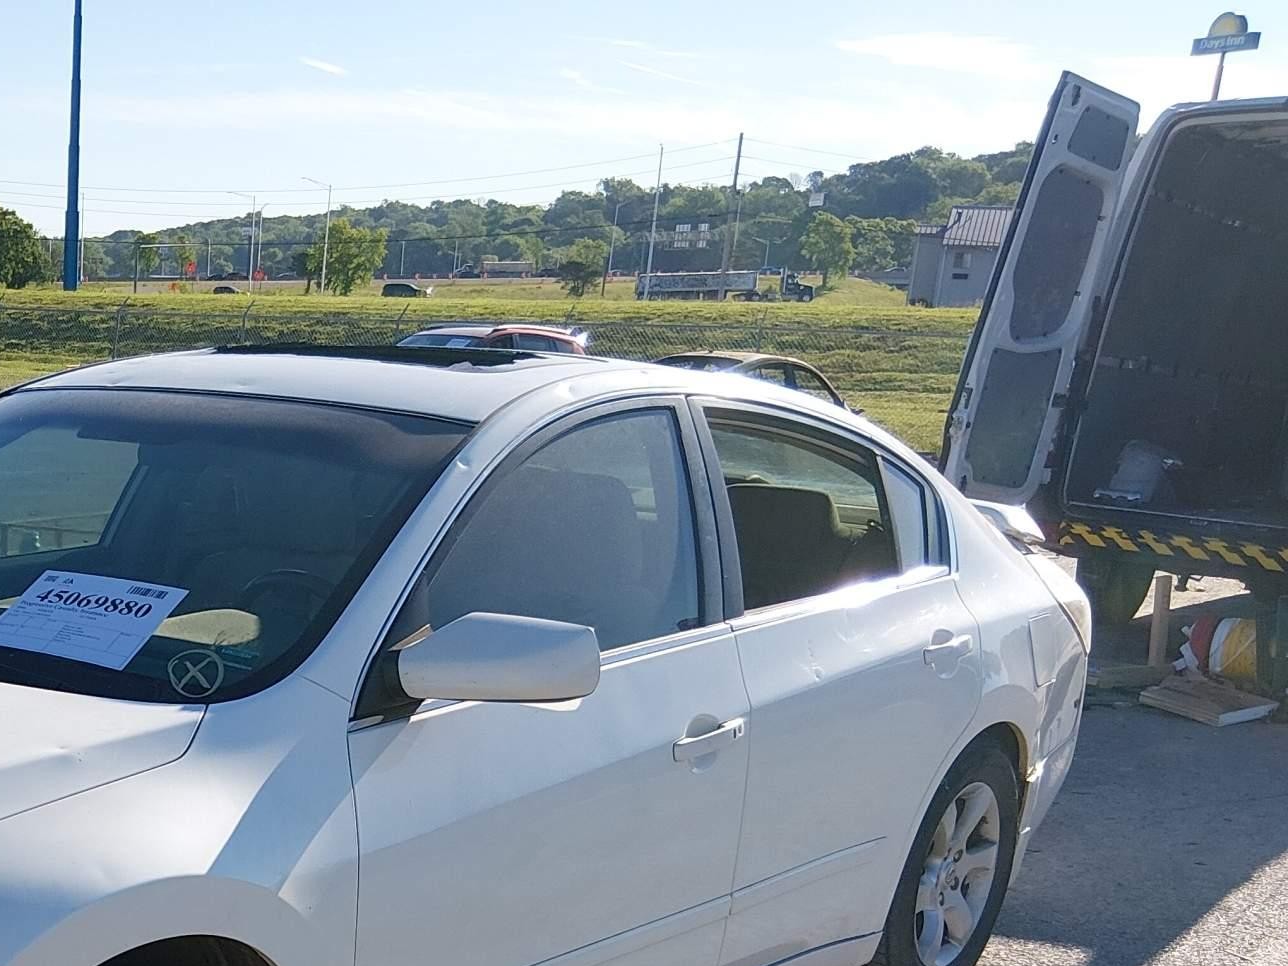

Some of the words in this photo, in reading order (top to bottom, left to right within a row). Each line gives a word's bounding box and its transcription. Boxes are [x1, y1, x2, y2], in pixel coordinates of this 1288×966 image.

[1199, 39, 1225, 49] Days
[1227, 36, 1246, 46] Inn
[36, 588, 153, 619] 45069880
